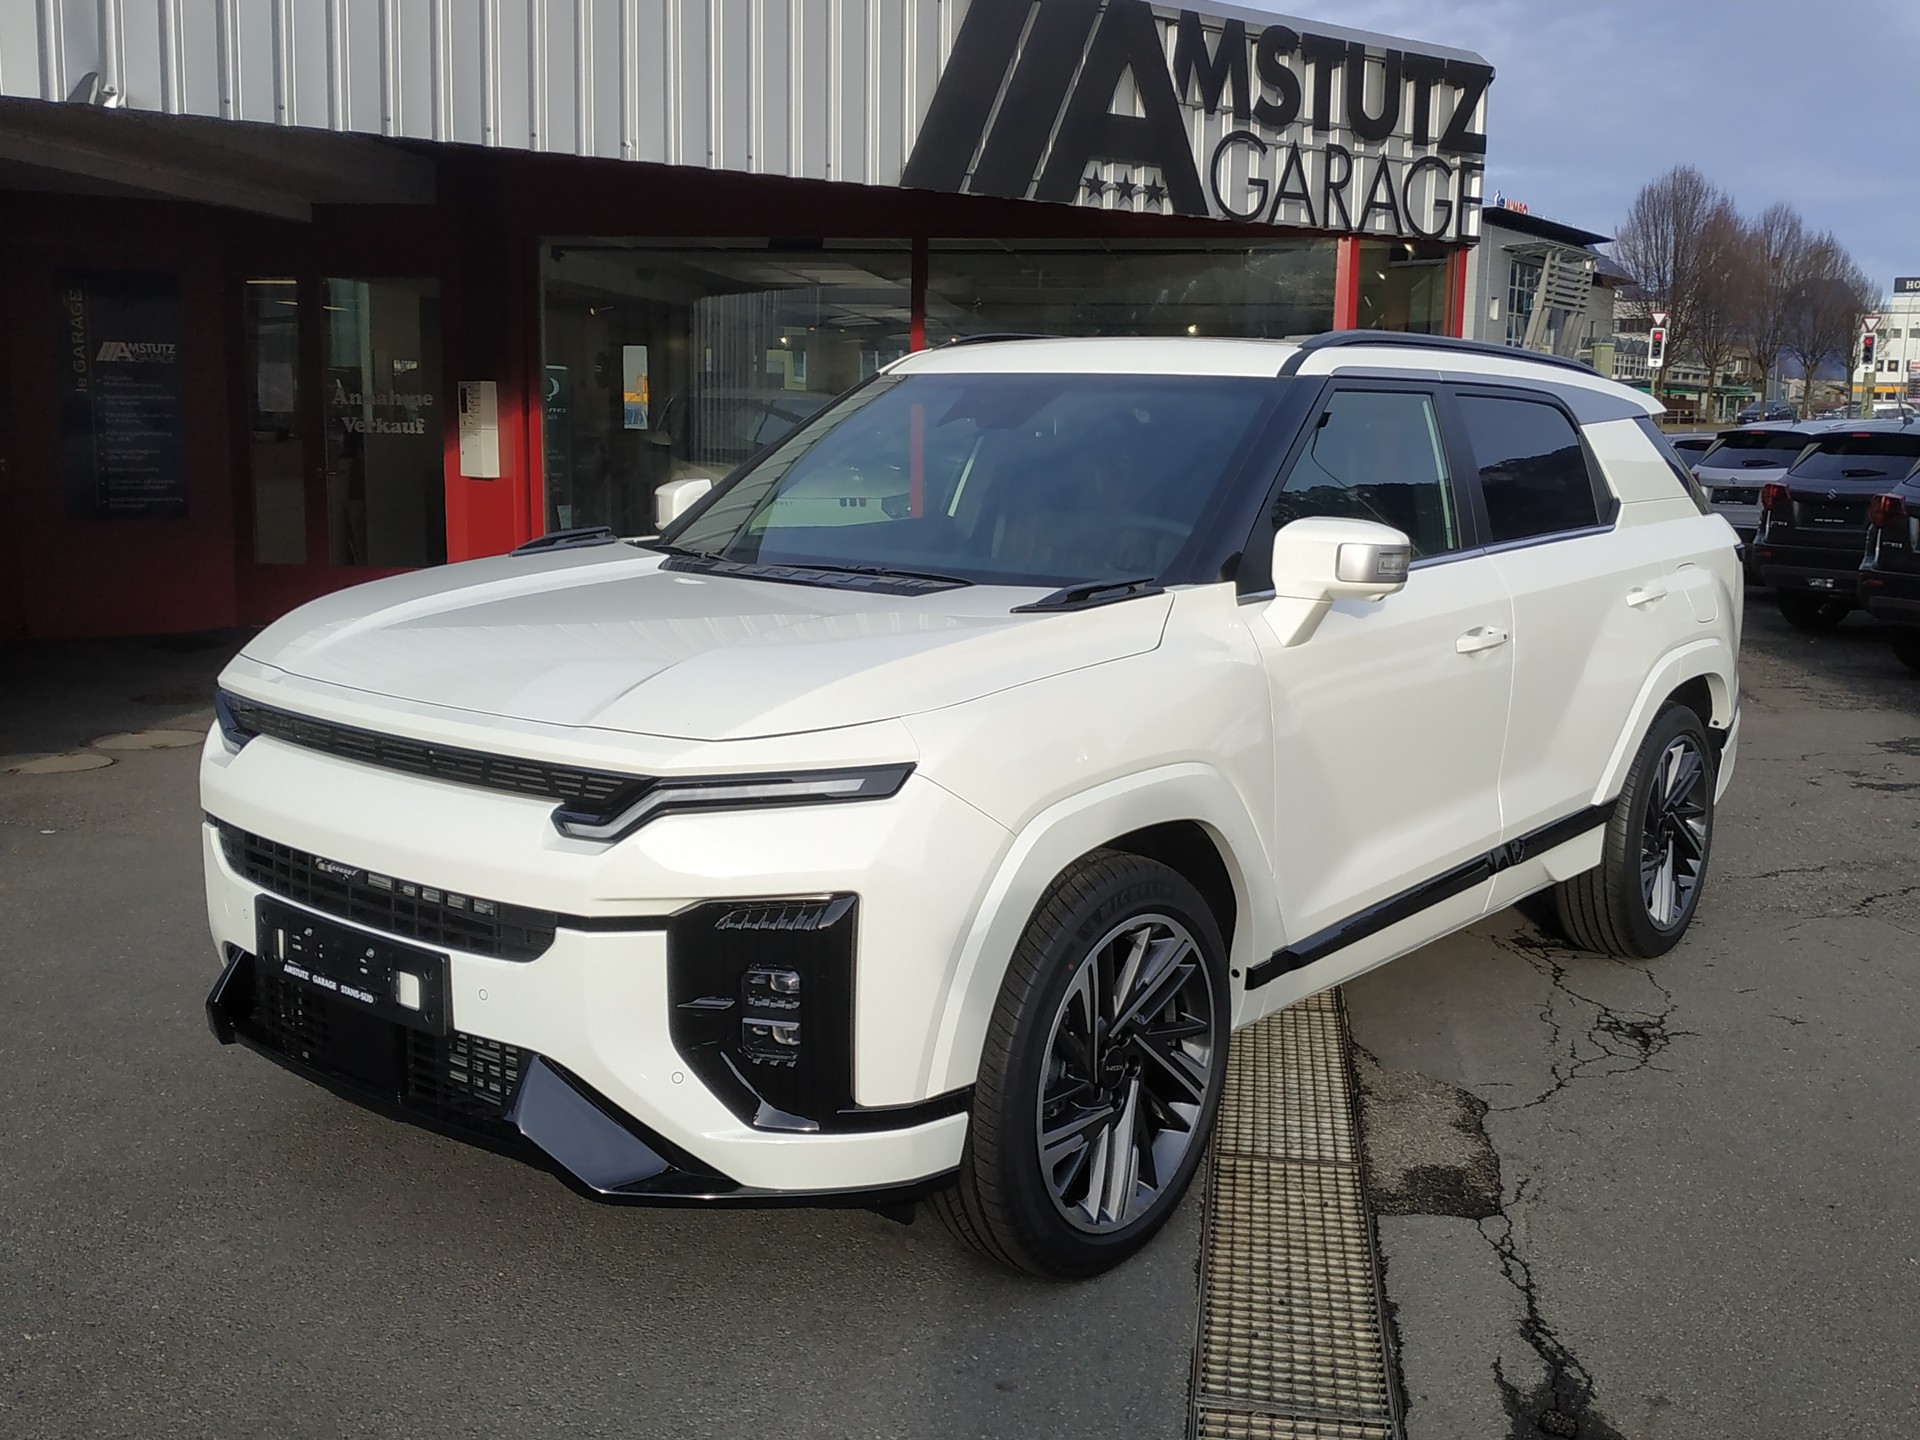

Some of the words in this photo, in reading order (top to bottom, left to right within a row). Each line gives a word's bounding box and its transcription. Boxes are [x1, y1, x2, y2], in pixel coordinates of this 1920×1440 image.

[1033, 0, 1493, 216] AMSTUTZ
[1210, 131, 1485, 244] GARAGE
[69, 289, 86, 373] GARAGE
[111, 341, 176, 361] AMSTUTZ
[75, 377, 87, 392] le
[330, 386, 434, 406] Anahe
[341, 416, 425, 435] Verkauf
[283, 963, 310, 980] AMSTUTZ
[312, 974, 337, 991] GARAGE
